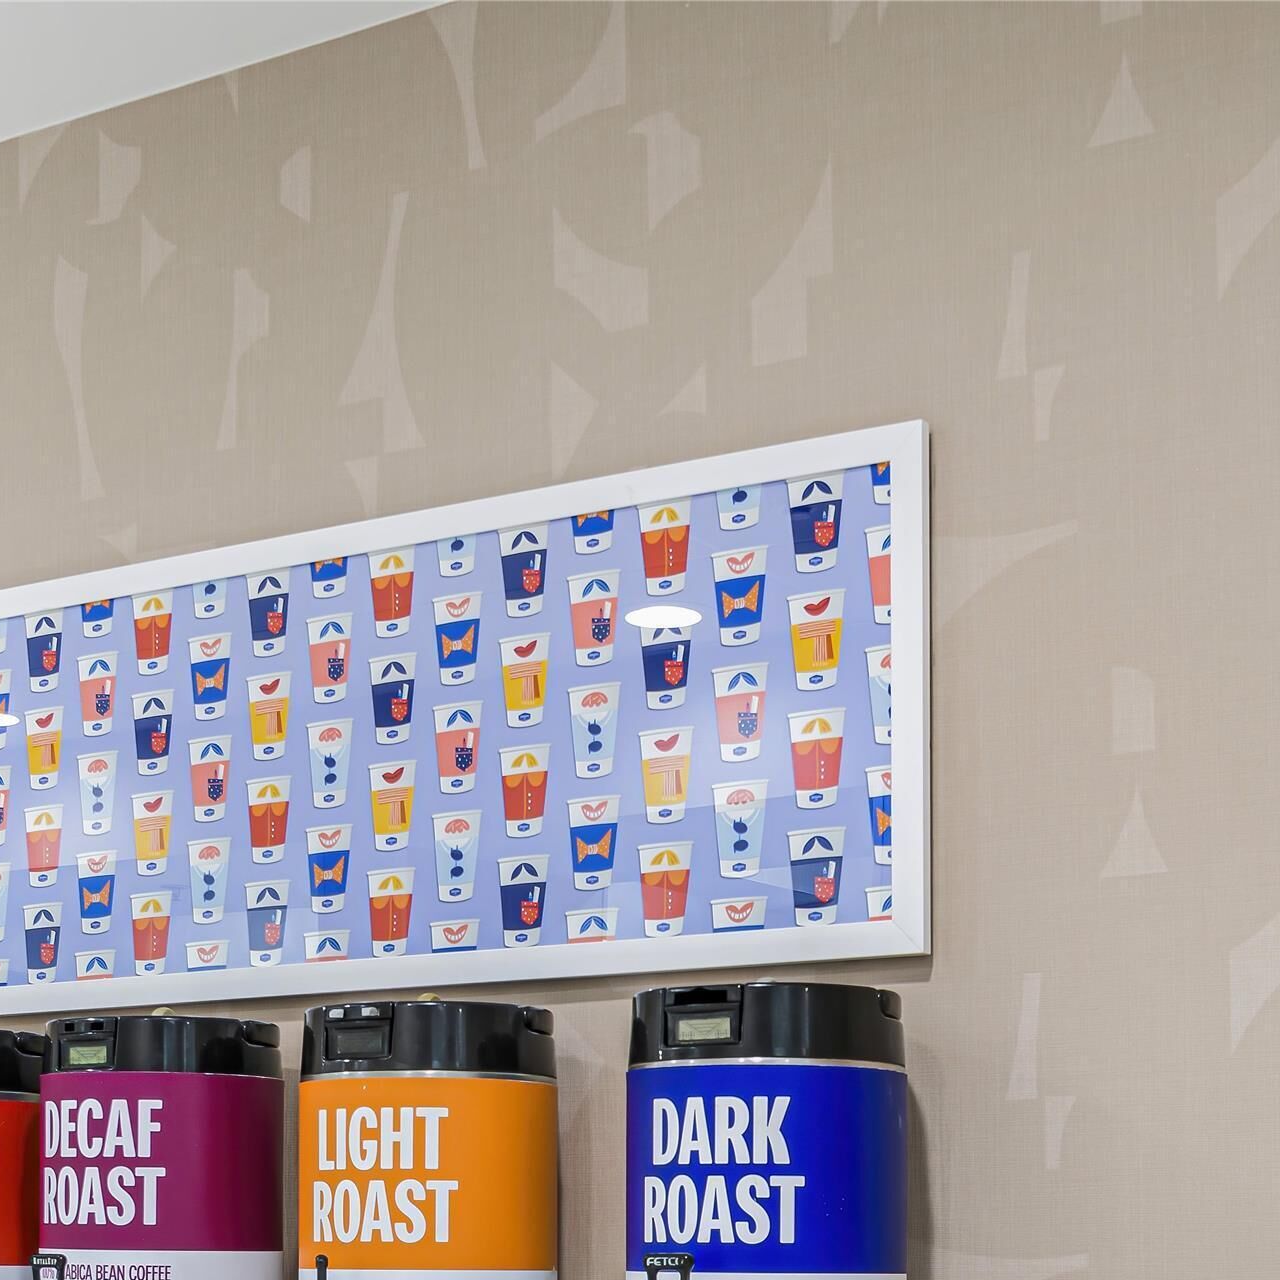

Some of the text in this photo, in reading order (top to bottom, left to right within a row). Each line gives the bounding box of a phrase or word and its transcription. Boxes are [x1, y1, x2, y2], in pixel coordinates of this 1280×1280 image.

[45, 1098, 163, 1158] DECAF
[318, 1106, 449, 1171] LIGHT
[653, 1096, 791, 1165] DARK
[44, 1165, 166, 1225] ROAST
[313, 1179, 459, 1244] ROAST
[644, 1174, 806, 1245] ROAST
[65, 1264, 92, 1280] ABICA
[96, 1265, 125, 1280] BEAN
